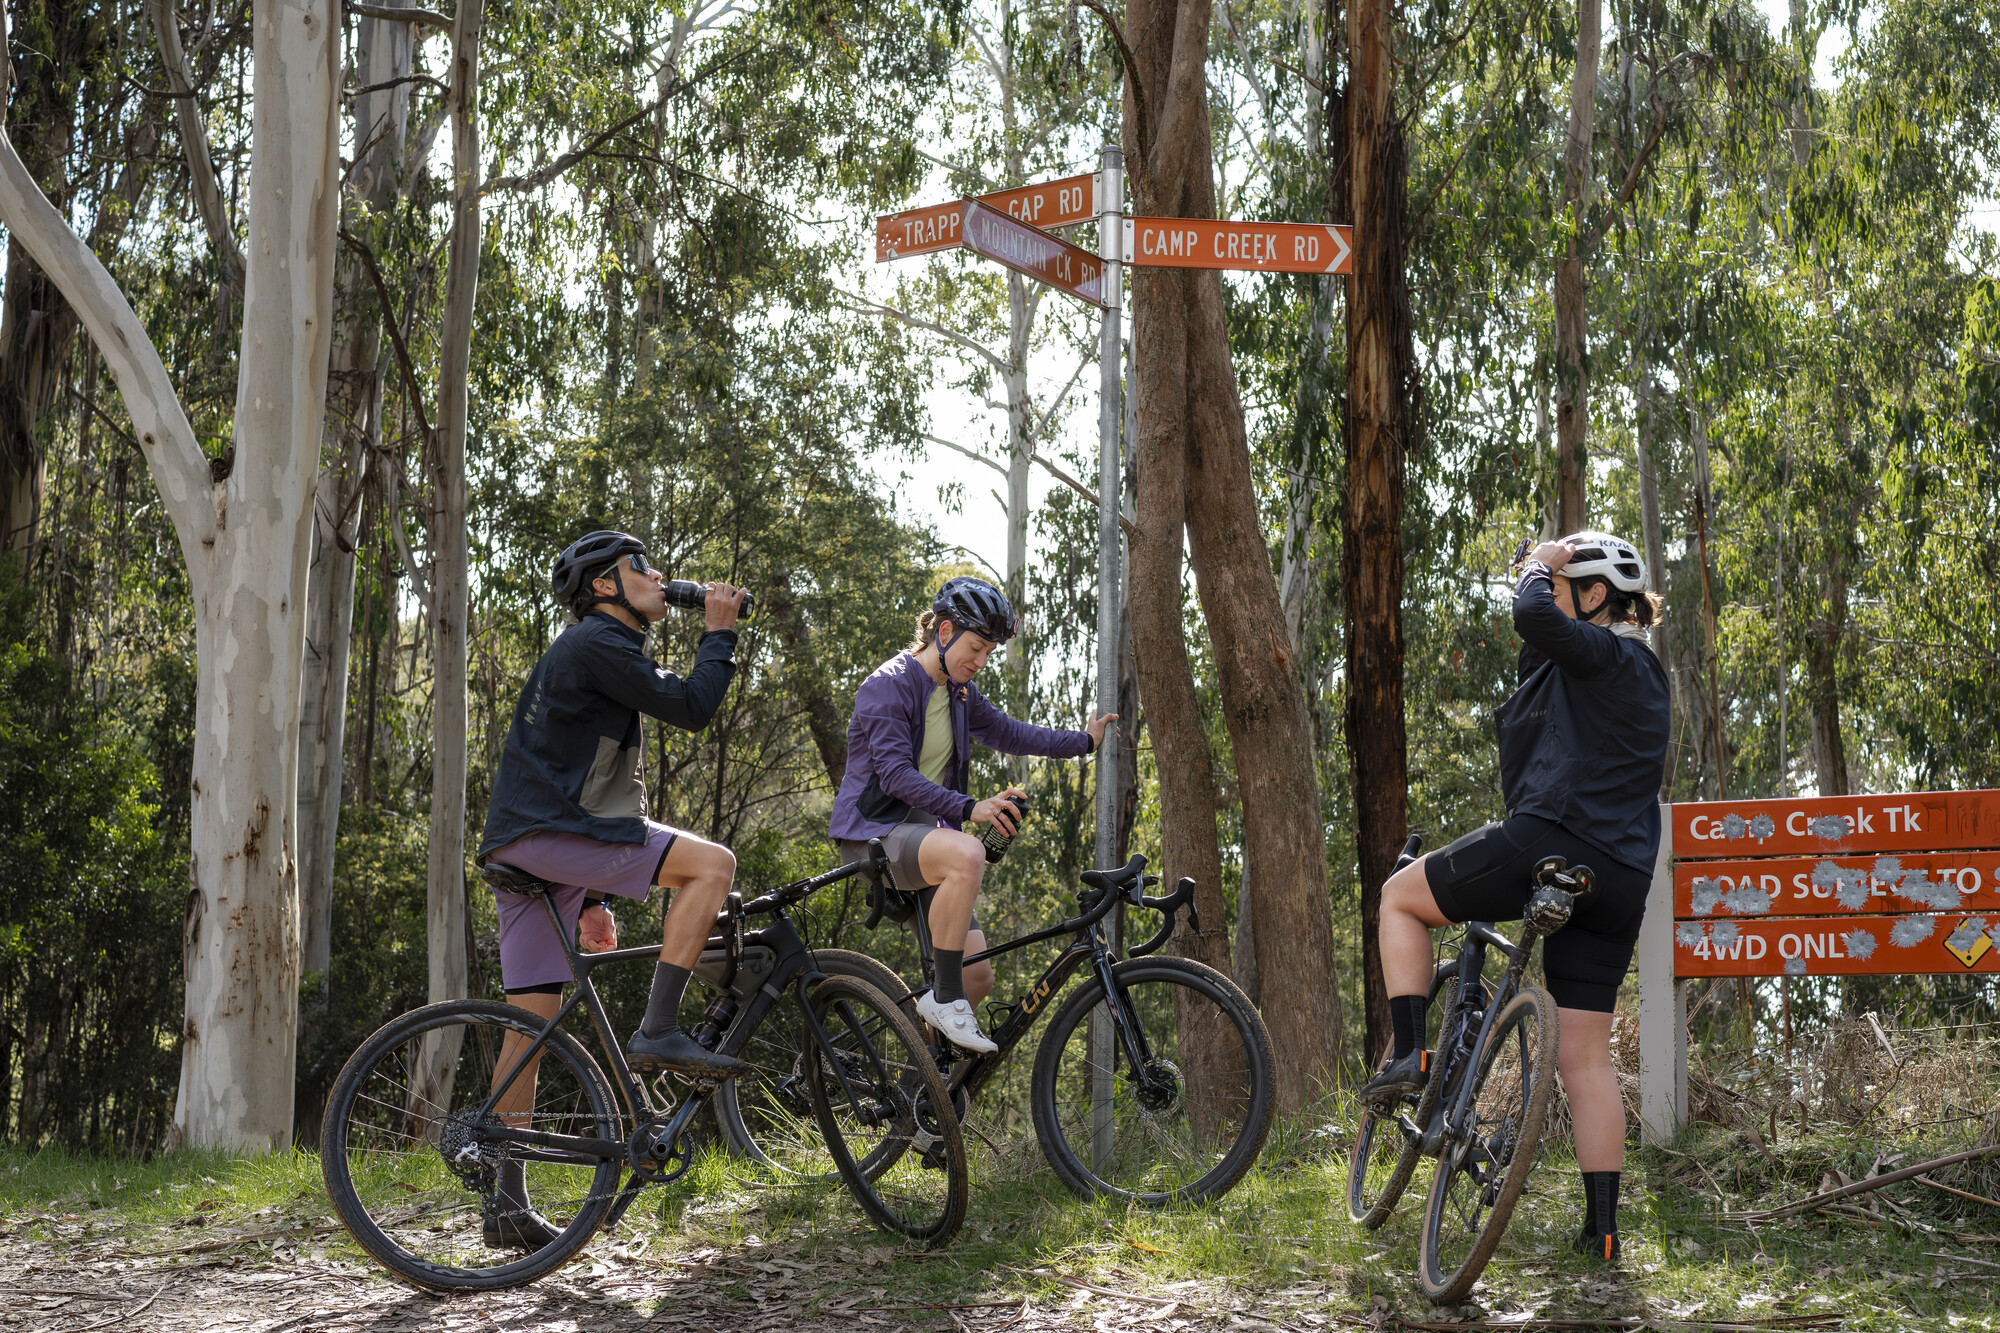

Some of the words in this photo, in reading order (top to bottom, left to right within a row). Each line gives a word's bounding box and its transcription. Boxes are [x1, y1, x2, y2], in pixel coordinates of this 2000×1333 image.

[904, 212, 960, 247] TRAPP
[1008, 194, 1044, 222] GAP
[1059, 186, 1083, 216] RD
[981, 217, 1047, 271] MOUNTAIN
[1056, 251, 1072, 283] CK
[1081, 262, 1096, 293] RD
[1142, 228, 1198, 257] CAMP
[1214, 232, 1277, 260] CREEK
[1294, 236, 1319, 262] RD
[1786, 806, 1876, 837] Crek
[1883, 804, 1922, 833] Tk
[1693, 935, 1767, 961] 4WD
[1778, 933, 1860, 960] ONL
